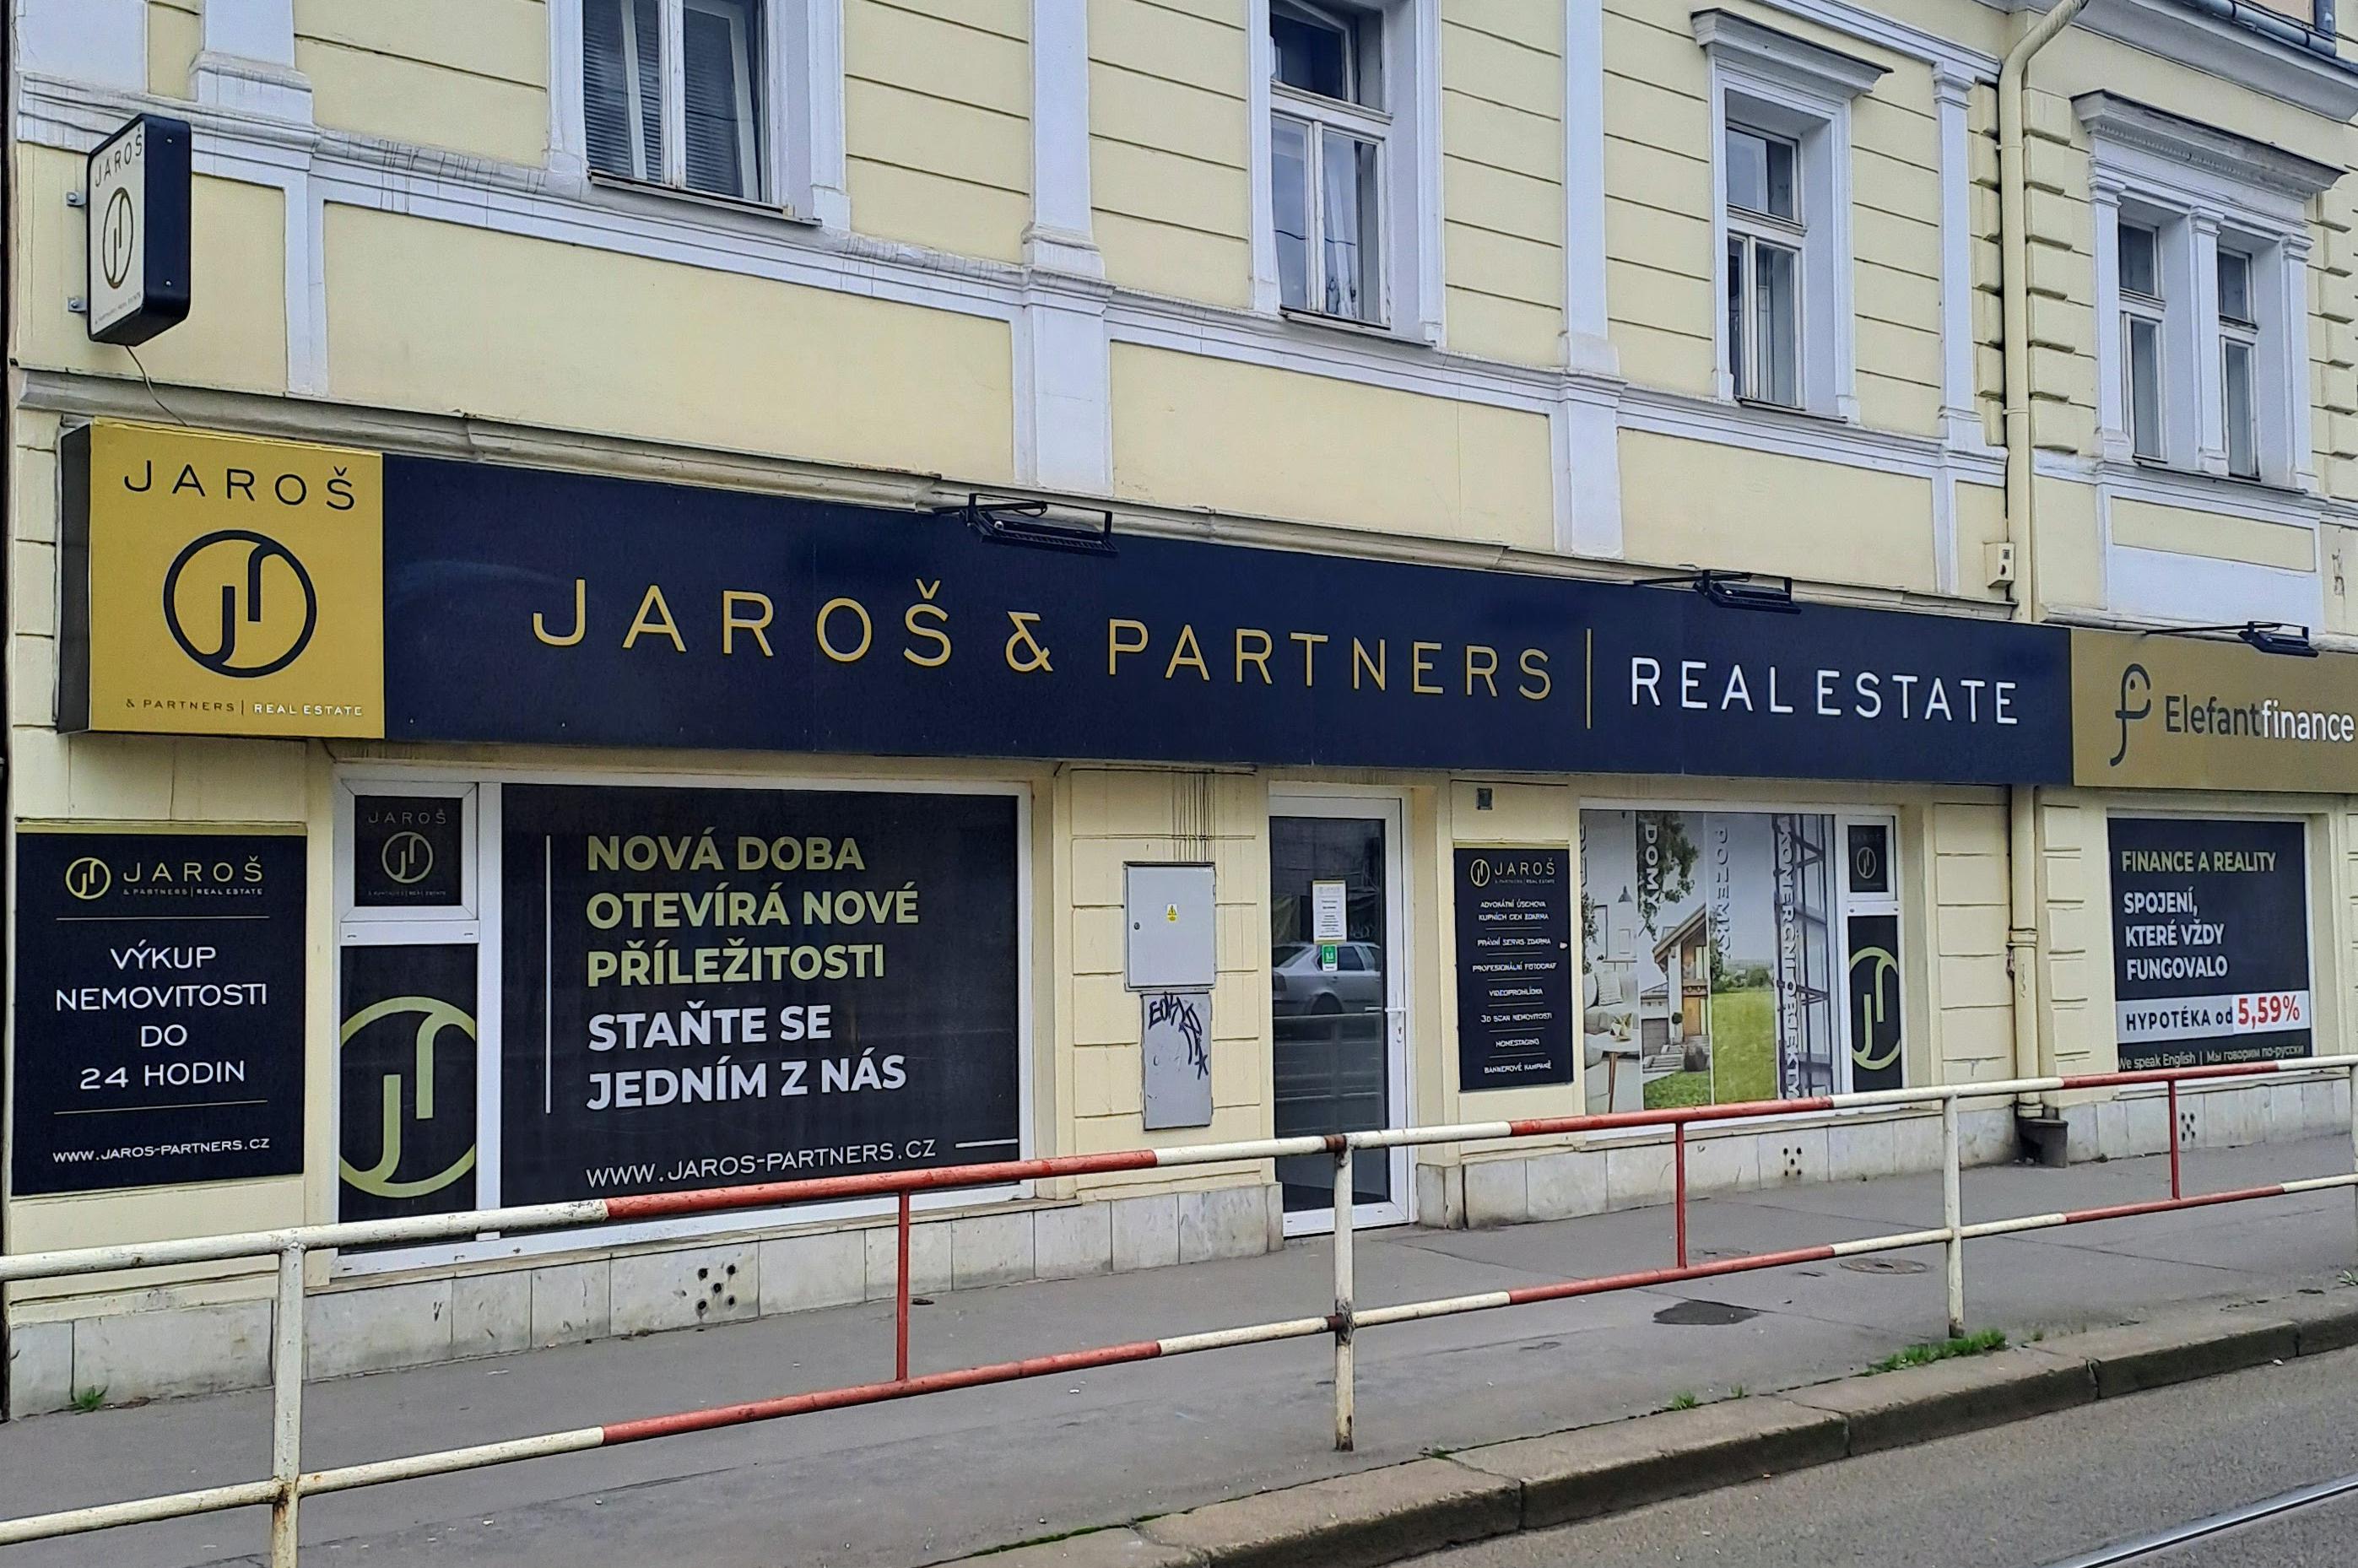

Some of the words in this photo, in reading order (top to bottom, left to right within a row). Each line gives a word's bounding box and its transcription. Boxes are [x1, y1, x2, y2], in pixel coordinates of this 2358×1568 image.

[95, 127, 143, 187] JAROŠ
[124, 460, 354, 510] JAROŠ
[533, 578, 952, 667] JAROŠ
[1005, 611, 1053, 673] &
[1108, 618, 1551, 700] PARTNERS
[1631, 657, 1793, 714] REAL
[1816, 670, 2018, 724] ESTATE
[126, 698, 135, 708] &
[143, 699, 235, 712] PARTNERS
[254, 703, 297, 715] REAL
[303, 705, 362, 716] ESTATE
[2165, 695, 2355, 743] Elefantfinance
[368, 808, 446, 825] JAROŠ
[587, 827, 724, 871] NOVÁ
[738, 836, 865, 871] DOBA
[2122, 851, 2193, 872] FINANCE
[2198, 851, 2210, 872] A
[2214, 852, 2276, 872] REALITY
[123, 855, 262, 883] JAROŠ
[1495, 857, 1555, 875] JAROŠ
[1645, 824, 1660, 912] DOMY
[133, 888, 188, 896] PARTNERS
[587, 882, 790, 929] OTEVÍRÁ
[803, 882, 919, 925] NOVÉ
[1480, 898, 1514, 907] ADVOKÁTNÍ
[1517, 898, 1546, 907] ÚSCHOVA
[2123, 887, 2198, 916] SPOJENÍ,
[1479, 912, 1506, 921] KUPNÍCH
[1477, 937, 1501, 946] PRÁVNÍ
[2125, 919, 2177, 947] KTERÉ
[2181, 918, 2225, 945] VŽDY
[111, 939, 216, 970] VÝKUP
[587, 938, 885, 987] PŘÍLEŽITOSTI
[1524, 962, 1557, 971] FOTOGRAF
[2127, 955, 2228, 981] FUNGOVALO
[57, 983, 268, 1012] NEMOVITOSTI
[588, 1000, 767, 1052] STAŇTE
[780, 1004, 831, 1041] SE
[2126, 1006, 2210, 1031] HYPOTÉKA
[2215, 1007, 2233, 1025] od
[2237, 994, 2301, 1030] 5,59%
[141, 1024, 187, 1047] DO
[2118, 1057, 2132, 1069] We
[2134, 1054, 2161, 1070] speak
[2162, 1051, 2196, 1068] English
[2206, 1050, 2221, 1062] Мы
[2223, 1049, 2260, 1062] говорим
[2261, 1045, 2305, 1060] по-русски
[80, 1067, 129, 1089] 24
[144, 1061, 245, 1087] HODIN
[586, 1056, 766, 1111] JEDNÍM
[780, 1061, 808, 1097] Z
[820, 1046, 907, 1094] NÁS
[53, 1138, 270, 1163] WWW.JAROS-PARTNERS.CZ
[586, 1138, 937, 1188] WWW.JAROS-PARTNERS.CZ
